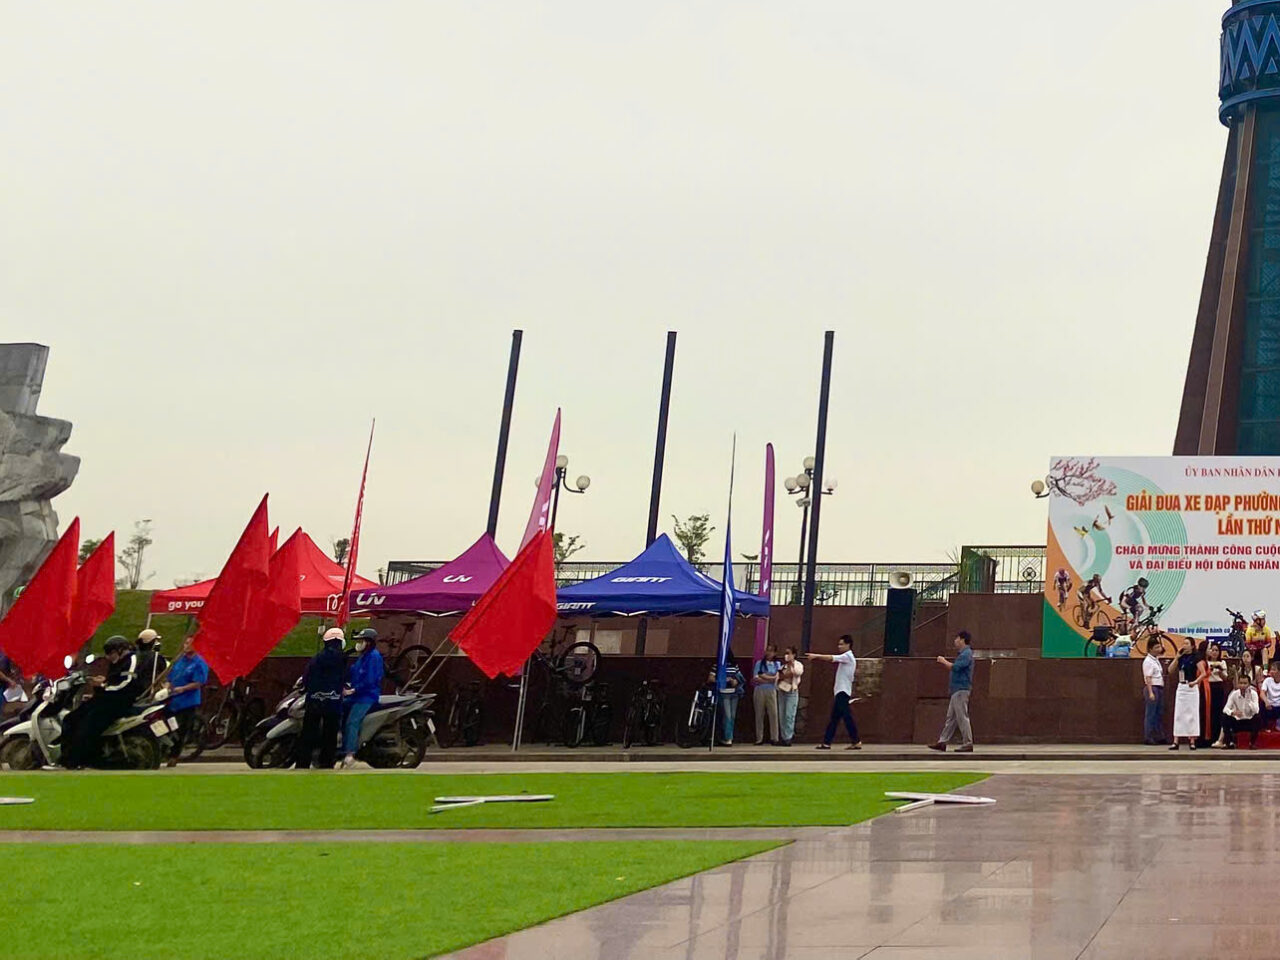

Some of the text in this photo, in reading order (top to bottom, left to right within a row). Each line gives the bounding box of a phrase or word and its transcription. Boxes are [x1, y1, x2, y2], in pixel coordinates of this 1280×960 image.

[1185, 464, 1198, 477] ỦY
[1201, 468, 1221, 477] BAN
[1223, 466, 1252, 477] NHÂN
[1254, 465, 1275, 478] DÂN
[1126, 490, 1152, 511] GIẢI
[1156, 494, 1181, 511] ĐUA
[1184, 495, 1201, 511] XE
[1205, 495, 1230, 515] ĐẠP
[1218, 514, 1243, 535] LẦN
[1247, 516, 1272, 535] THỨ
[1116, 543, 1144, 555] CHÀO
[1148, 543, 1180, 555] MỪNG
[1184, 543, 1219, 555] THÀNH
[1223, 543, 1252, 555] CÔNG
[1130, 559, 1143, 570] VÀ
[1146, 561, 1164, 573] ĐẠI
[1168, 558, 1192, 570] BIỂU
[1196, 559, 1213, 571] HỘI
[1216, 558, 1246, 570] ĐỒNG
[1250, 559, 1279, 570] NHÂN
[168, 601, 182, 611] go
[356, 593, 386, 606] Liv
